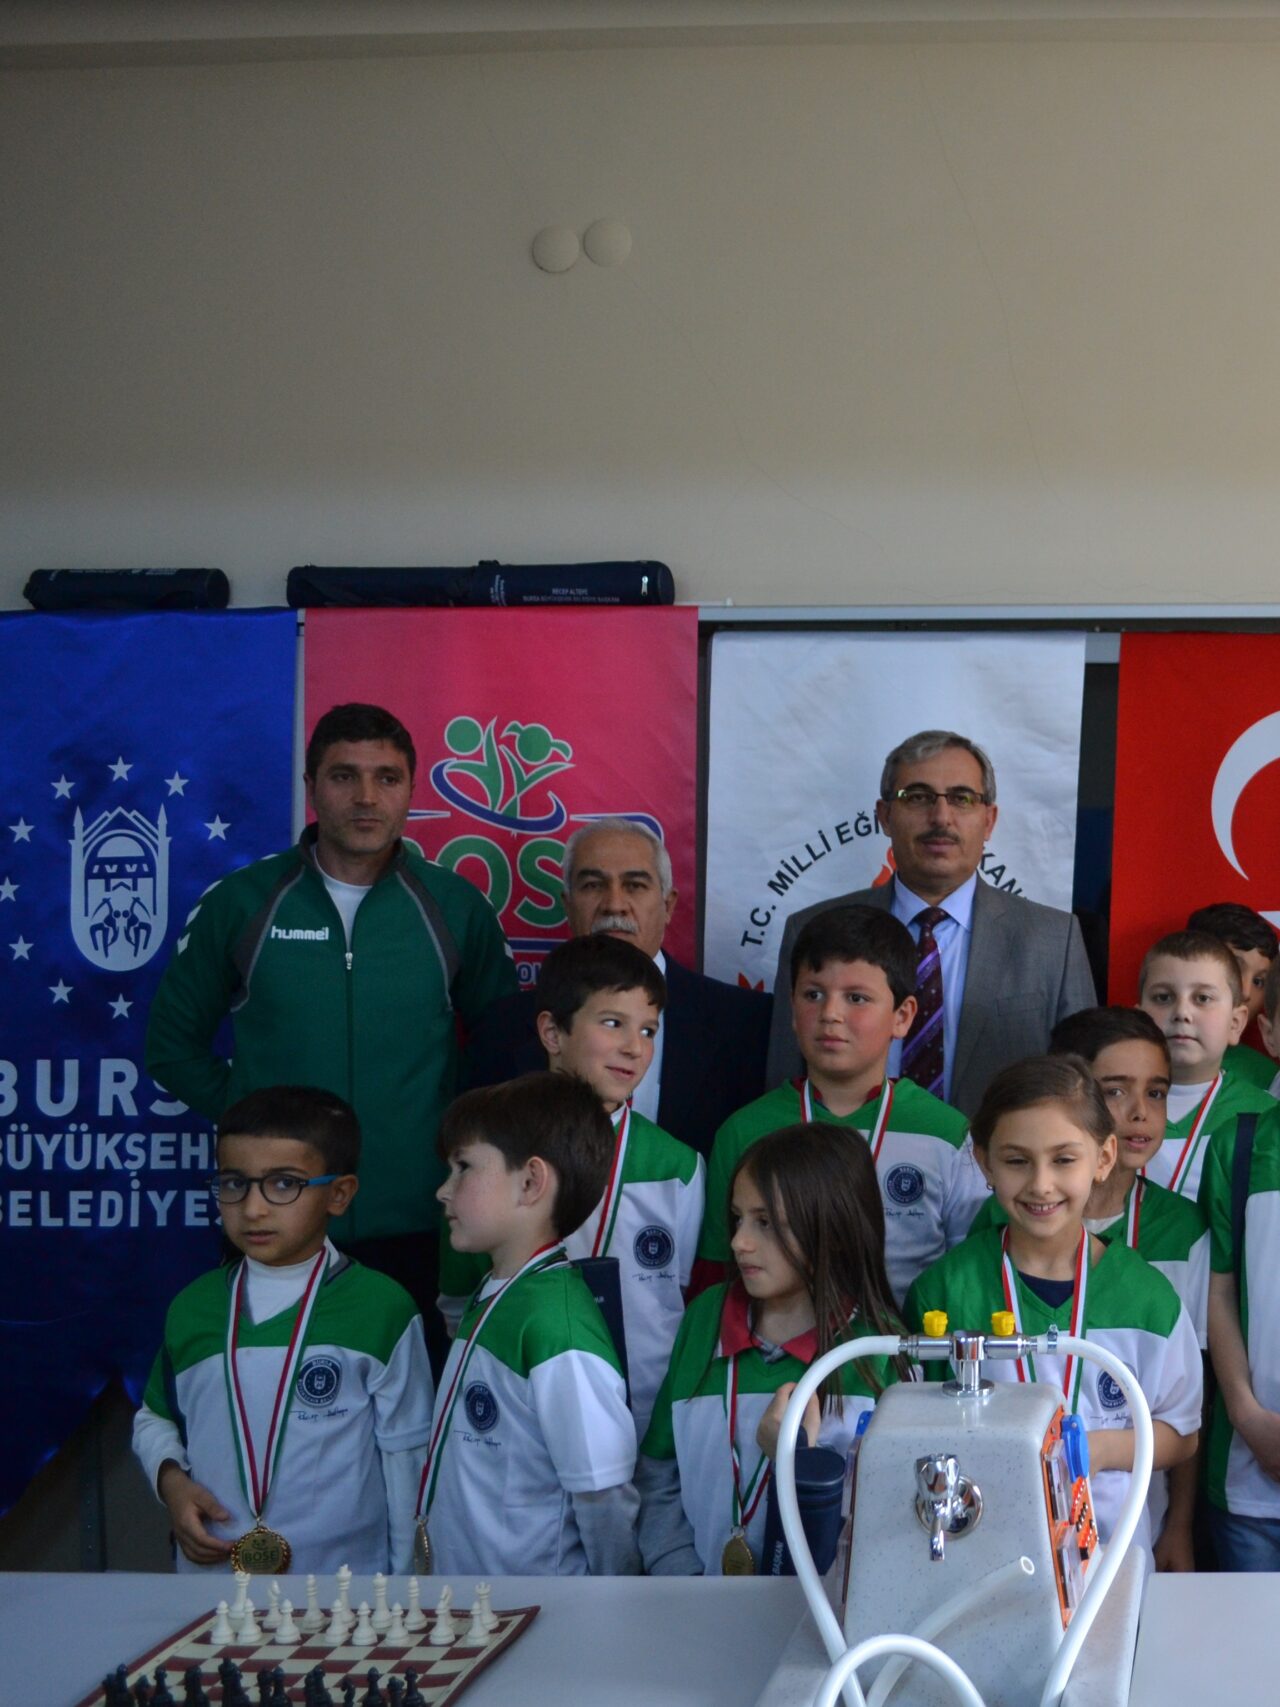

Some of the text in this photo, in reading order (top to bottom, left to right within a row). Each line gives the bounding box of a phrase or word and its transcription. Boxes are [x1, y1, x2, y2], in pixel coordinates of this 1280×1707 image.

[741, 904, 777, 948] T.C.
[767, 829, 832, 896] MİLLİ
[835, 811, 879, 846] EĞİ
[271, 925, 329, 940] hummel
[243, 1550, 278, 1562] BOSE
